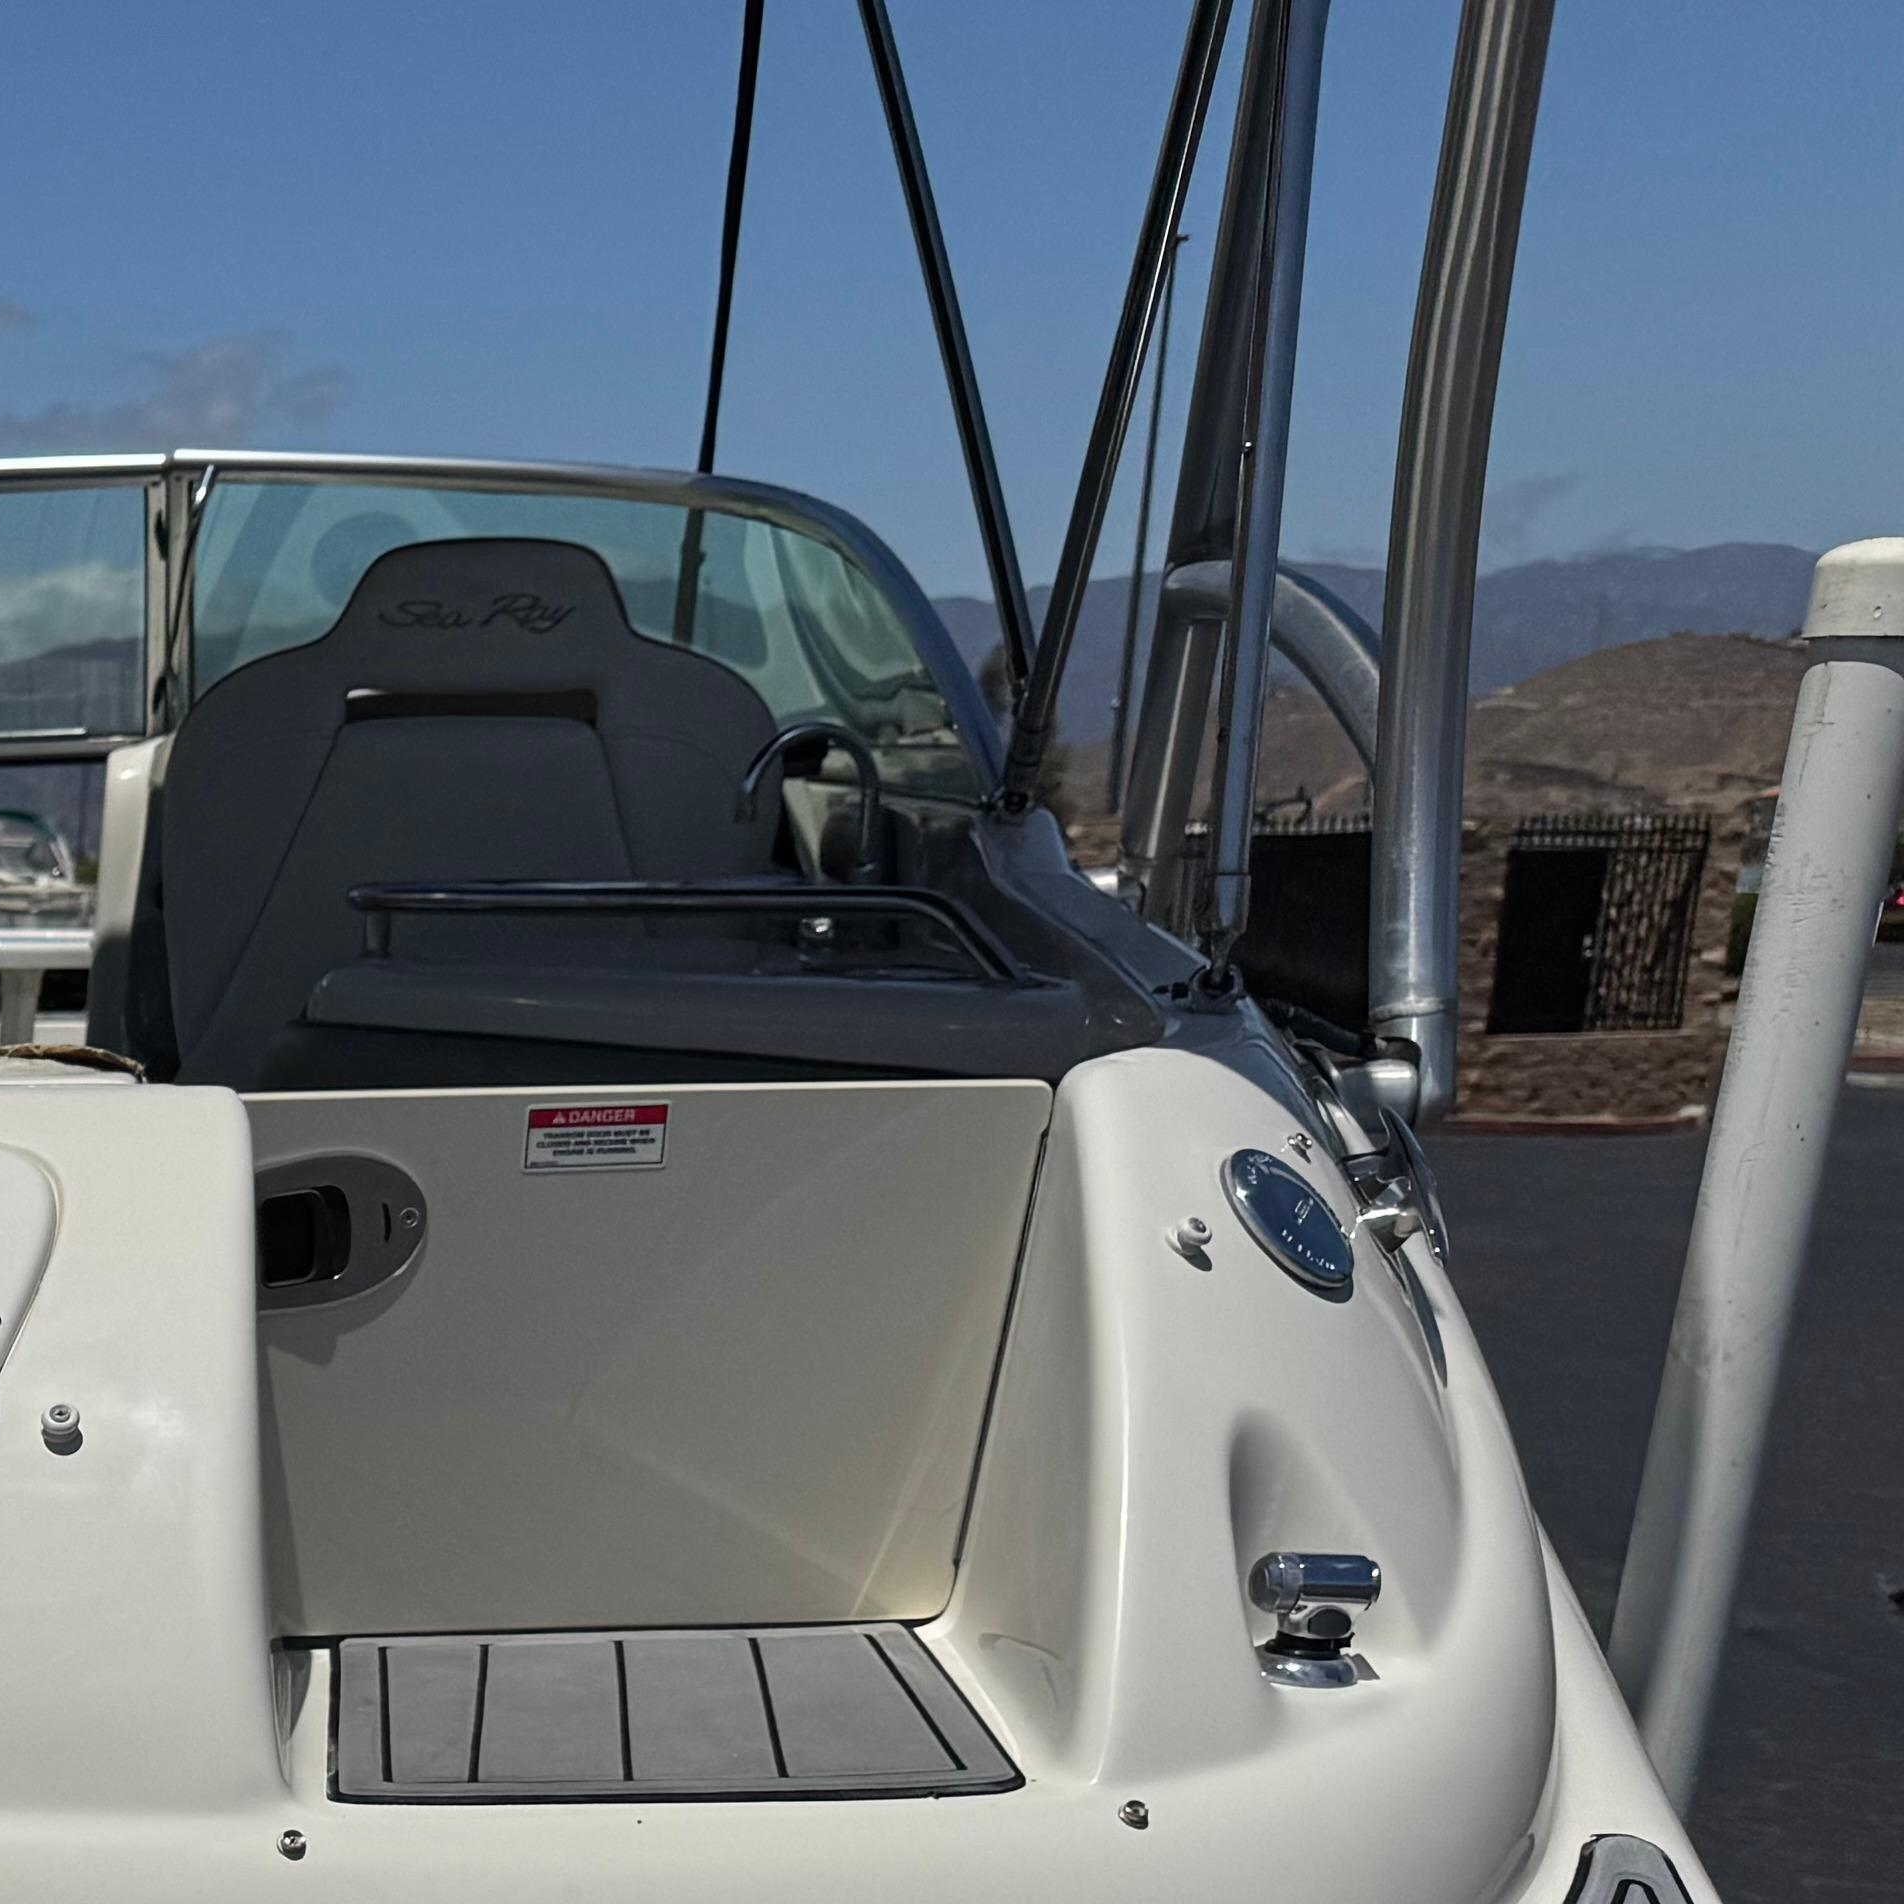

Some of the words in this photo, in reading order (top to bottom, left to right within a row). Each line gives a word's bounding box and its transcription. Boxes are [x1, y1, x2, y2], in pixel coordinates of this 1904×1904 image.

[378, 600, 473, 630] Sea
[480, 593, 577, 634] Ray
[568, 1109, 635, 1123] DANGER
